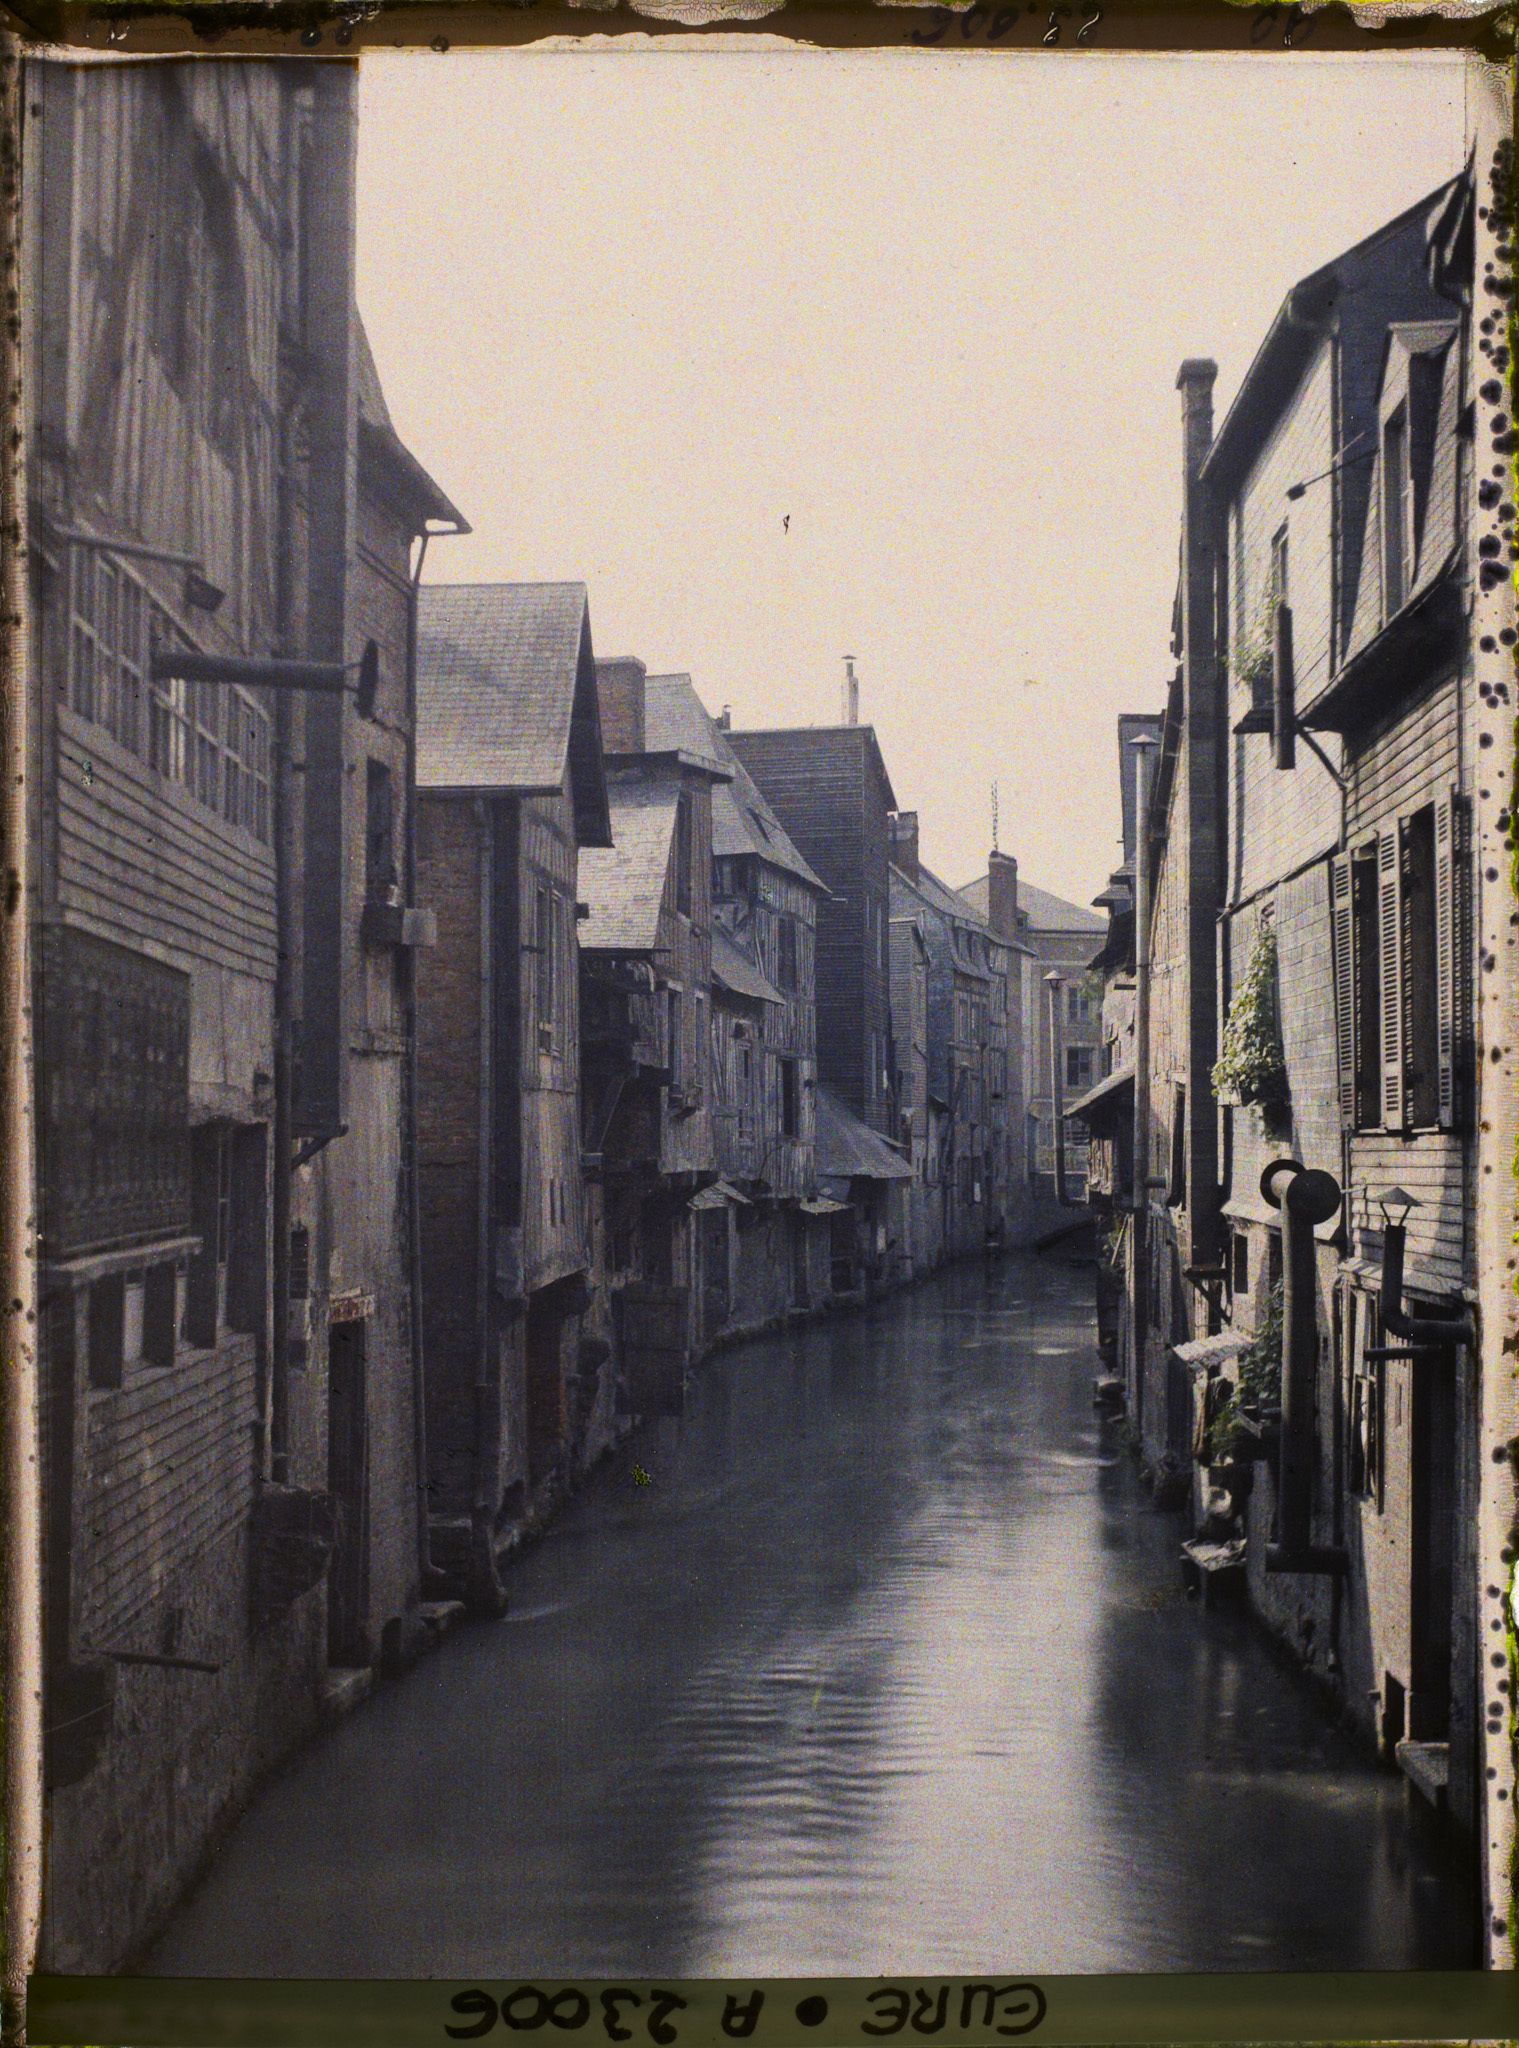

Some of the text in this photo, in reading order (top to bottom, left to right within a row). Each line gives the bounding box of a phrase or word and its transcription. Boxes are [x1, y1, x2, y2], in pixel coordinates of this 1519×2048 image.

[444, 1983, 1047, 2046] EURE A 23006
